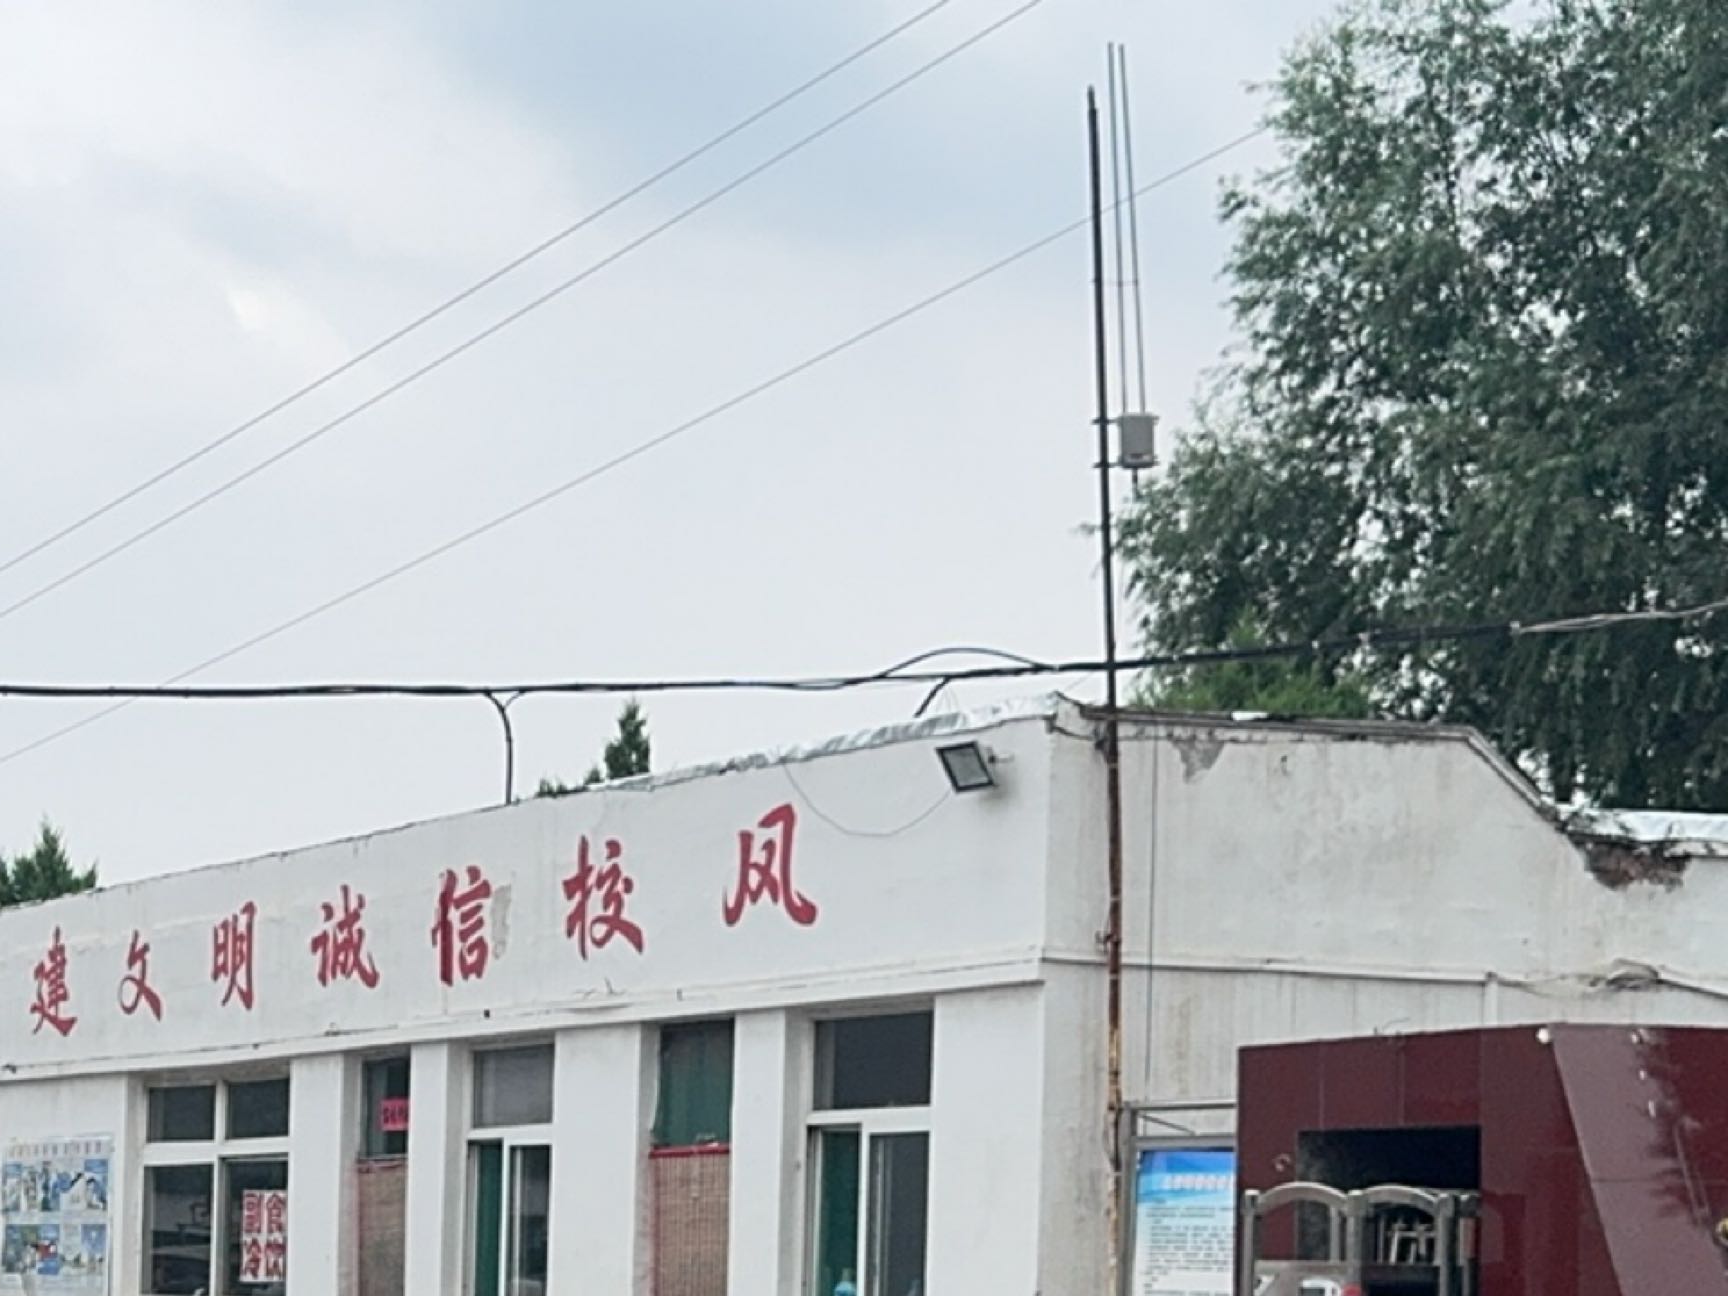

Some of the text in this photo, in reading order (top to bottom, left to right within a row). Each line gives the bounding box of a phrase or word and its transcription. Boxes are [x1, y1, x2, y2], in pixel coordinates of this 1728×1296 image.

[30, 803, 818, 1038] 建文明诚信校风
